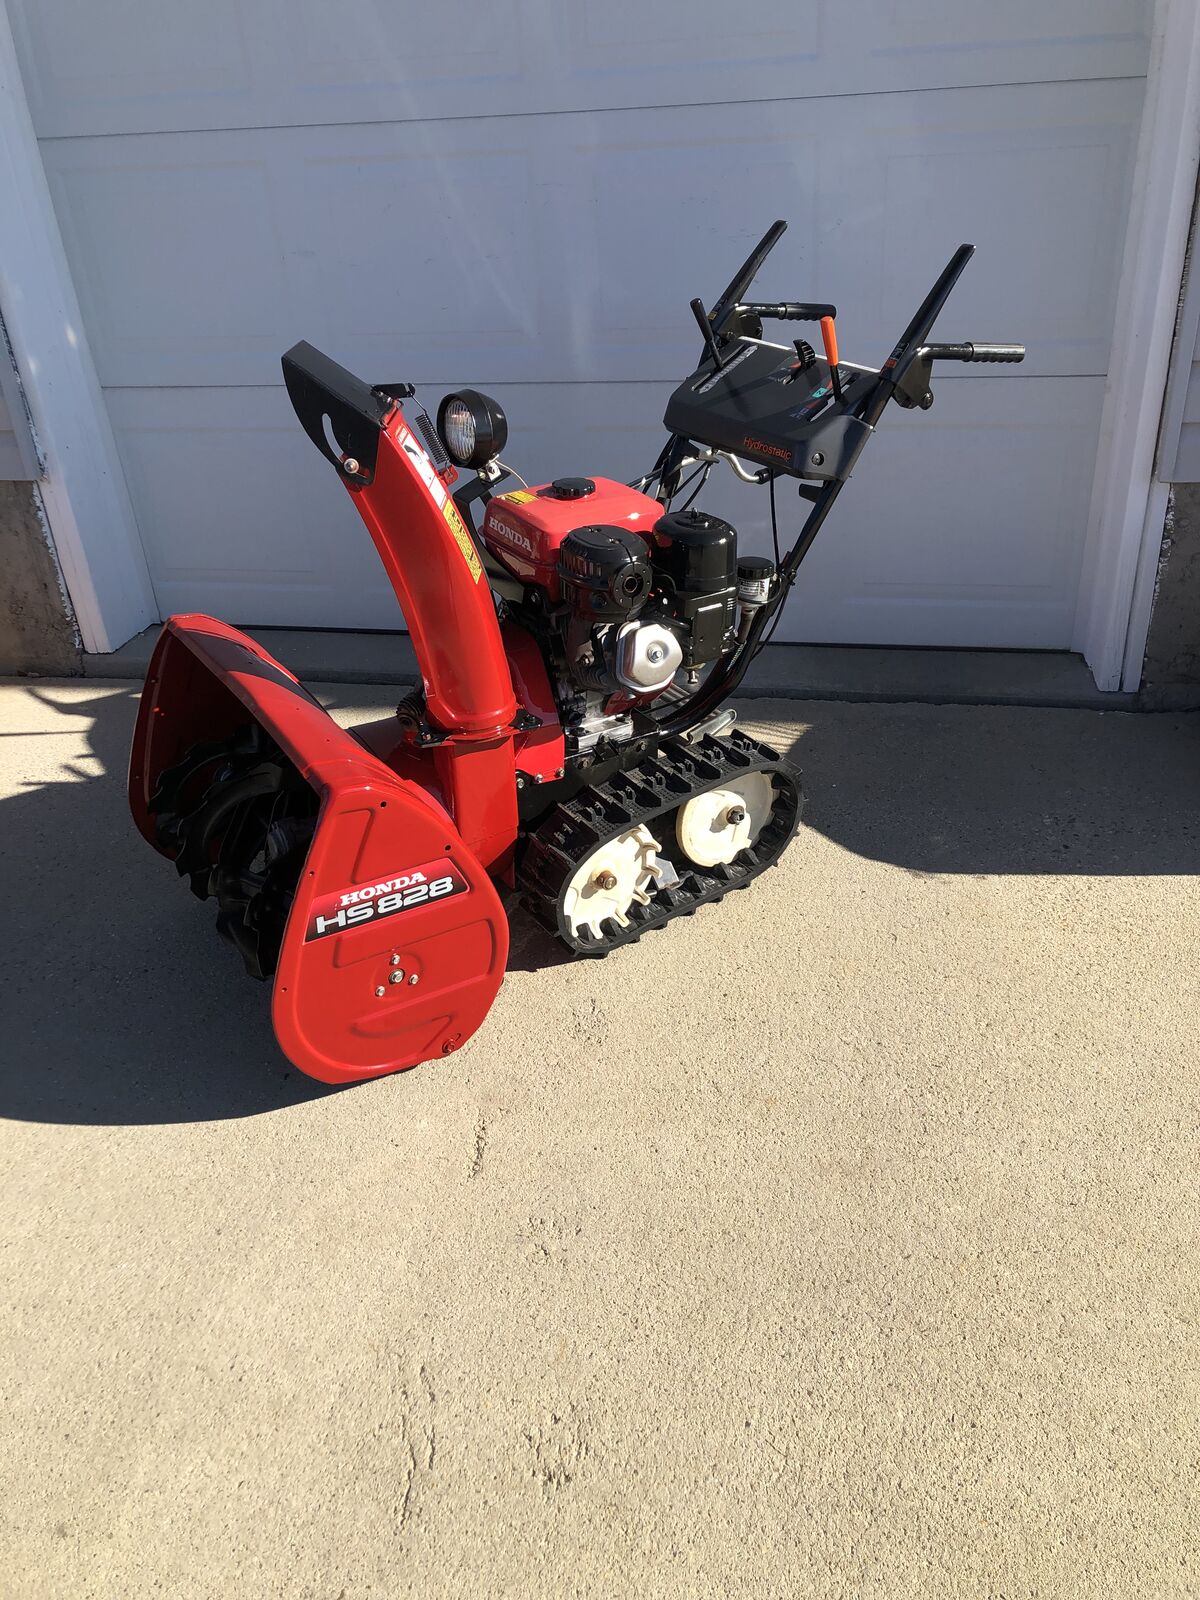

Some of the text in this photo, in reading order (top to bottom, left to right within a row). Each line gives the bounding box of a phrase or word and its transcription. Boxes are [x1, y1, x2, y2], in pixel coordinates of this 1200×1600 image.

[743, 437, 792, 461] Hydrostatic
[488, 515, 533, 552] HONDA
[339, 871, 427, 906] HONDA
